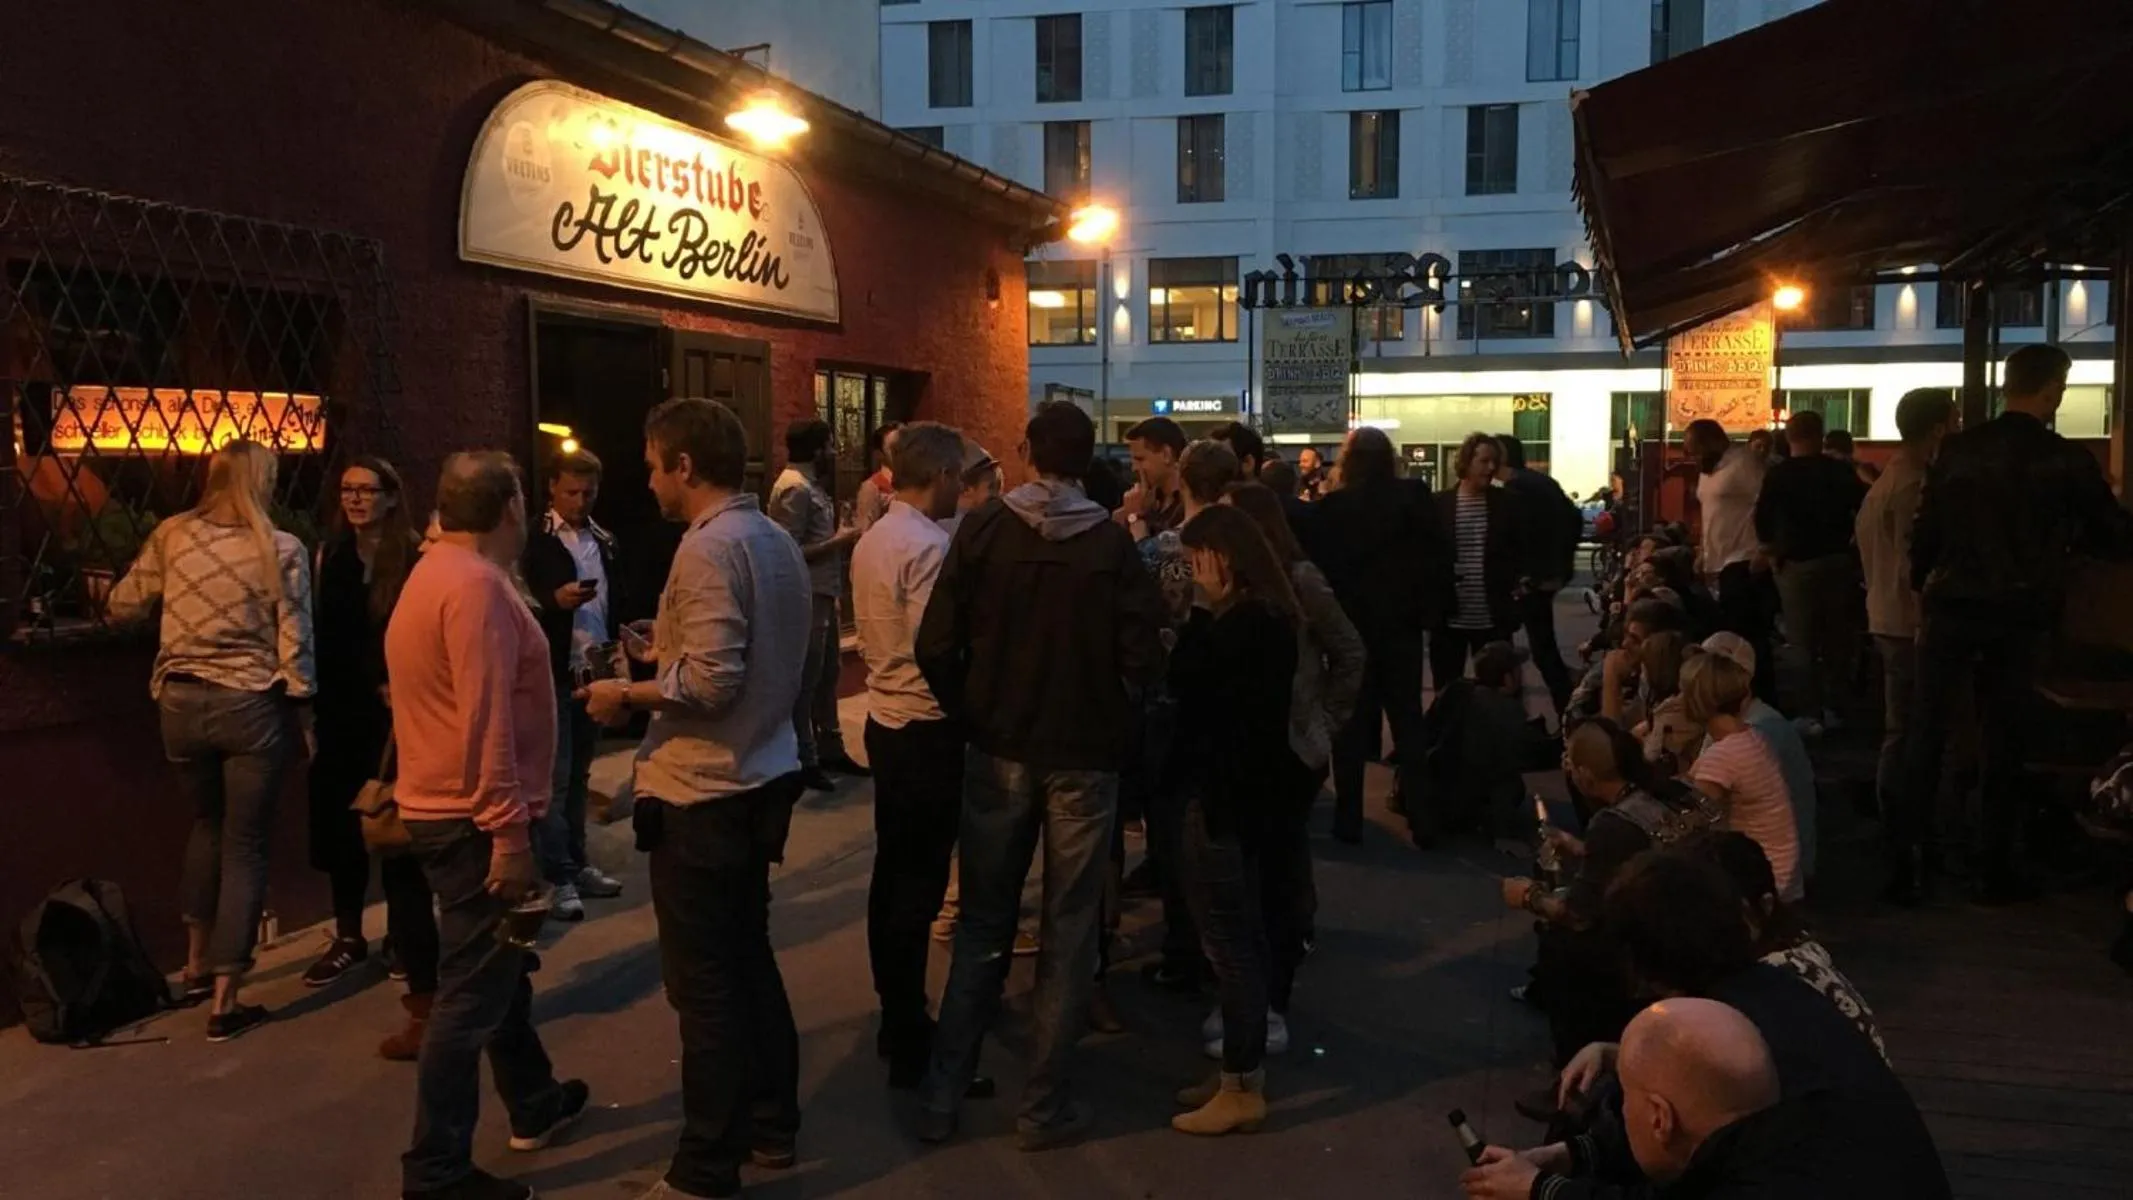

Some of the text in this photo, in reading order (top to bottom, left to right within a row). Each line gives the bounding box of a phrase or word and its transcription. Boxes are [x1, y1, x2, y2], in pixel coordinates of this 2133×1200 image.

[551, 183, 790, 290] Alt Berlin
[1172, 400, 1222, 411] PARKING
